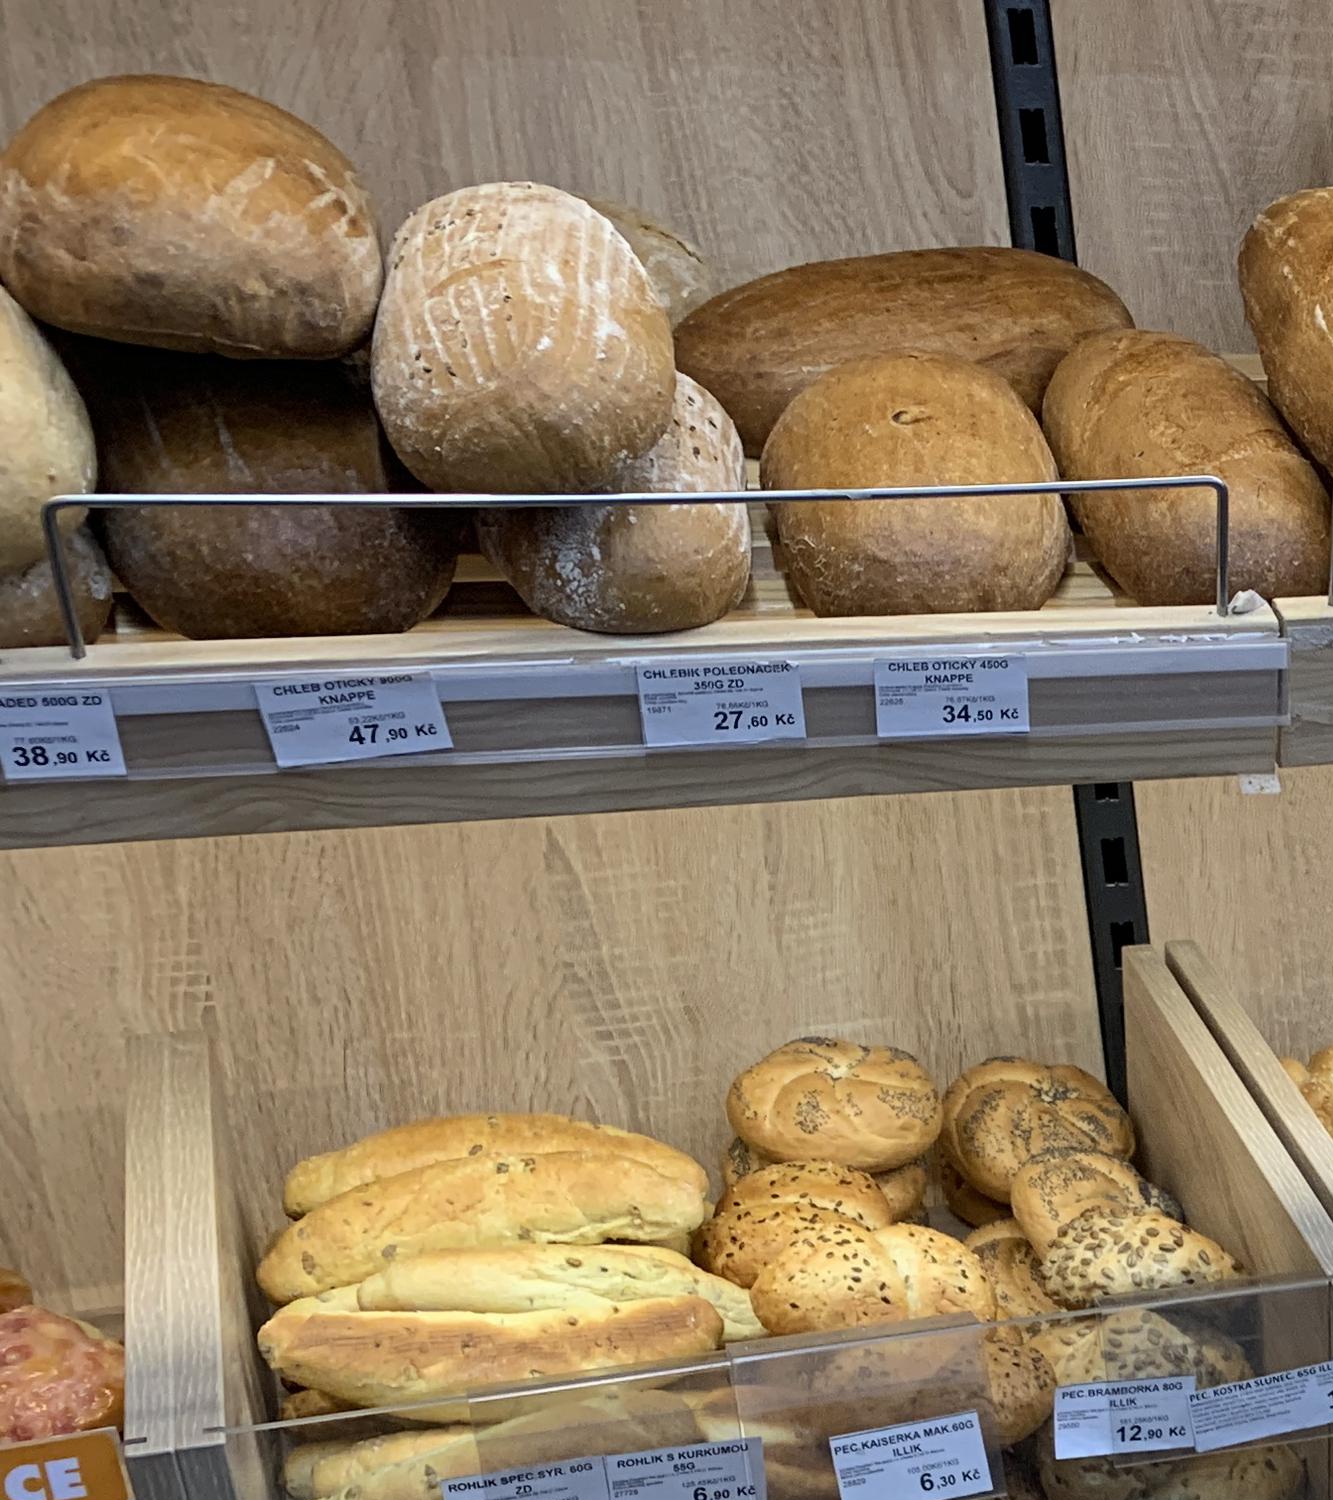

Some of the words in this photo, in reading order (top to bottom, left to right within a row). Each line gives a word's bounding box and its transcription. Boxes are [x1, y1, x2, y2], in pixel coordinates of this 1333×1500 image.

[888, 661, 929, 671] CHLEB
[932, 660, 977, 671] OTICKY
[980, 659, 1009, 669] 450G
[643, 667, 700, 679] CHLEBIK
[925, 673, 974, 684] KNAPPE
[273, 682, 321, 697] CHLEB
[325, 677, 375, 691] OTICKY
[694, 680, 724, 691] 350G
[728, 679, 744, 689] ZD
[83, 695, 102, 706] ZD
[319, 690, 376, 705] KNAPPE
[775, 712, 796, 725] Kč
[1000, 708, 1020, 719] Kč
[415, 723, 438, 737] Kč
[86, 749, 111, 762] Kč
[1163, 1381, 1184, 1392] 80G
[1213, 1382, 1252, 1397] KOSTKA
[1109, 1397, 1137, 1408] ILLIK
[1169, 1426, 1187, 1437] Kč
[617, 1455, 663, 1469] ROHLIK
[667, 1453, 674, 1462] S
[678, 1442, 749, 1460] KURKUMOU
[892, 1444, 922, 1457] ILLIK
[962, 1468, 981, 1483] Kč
[448, 1478, 497, 1493] ROHLIK
[515, 1484, 533, 1495] ZD
[737, 1485, 756, 1497] Kč
